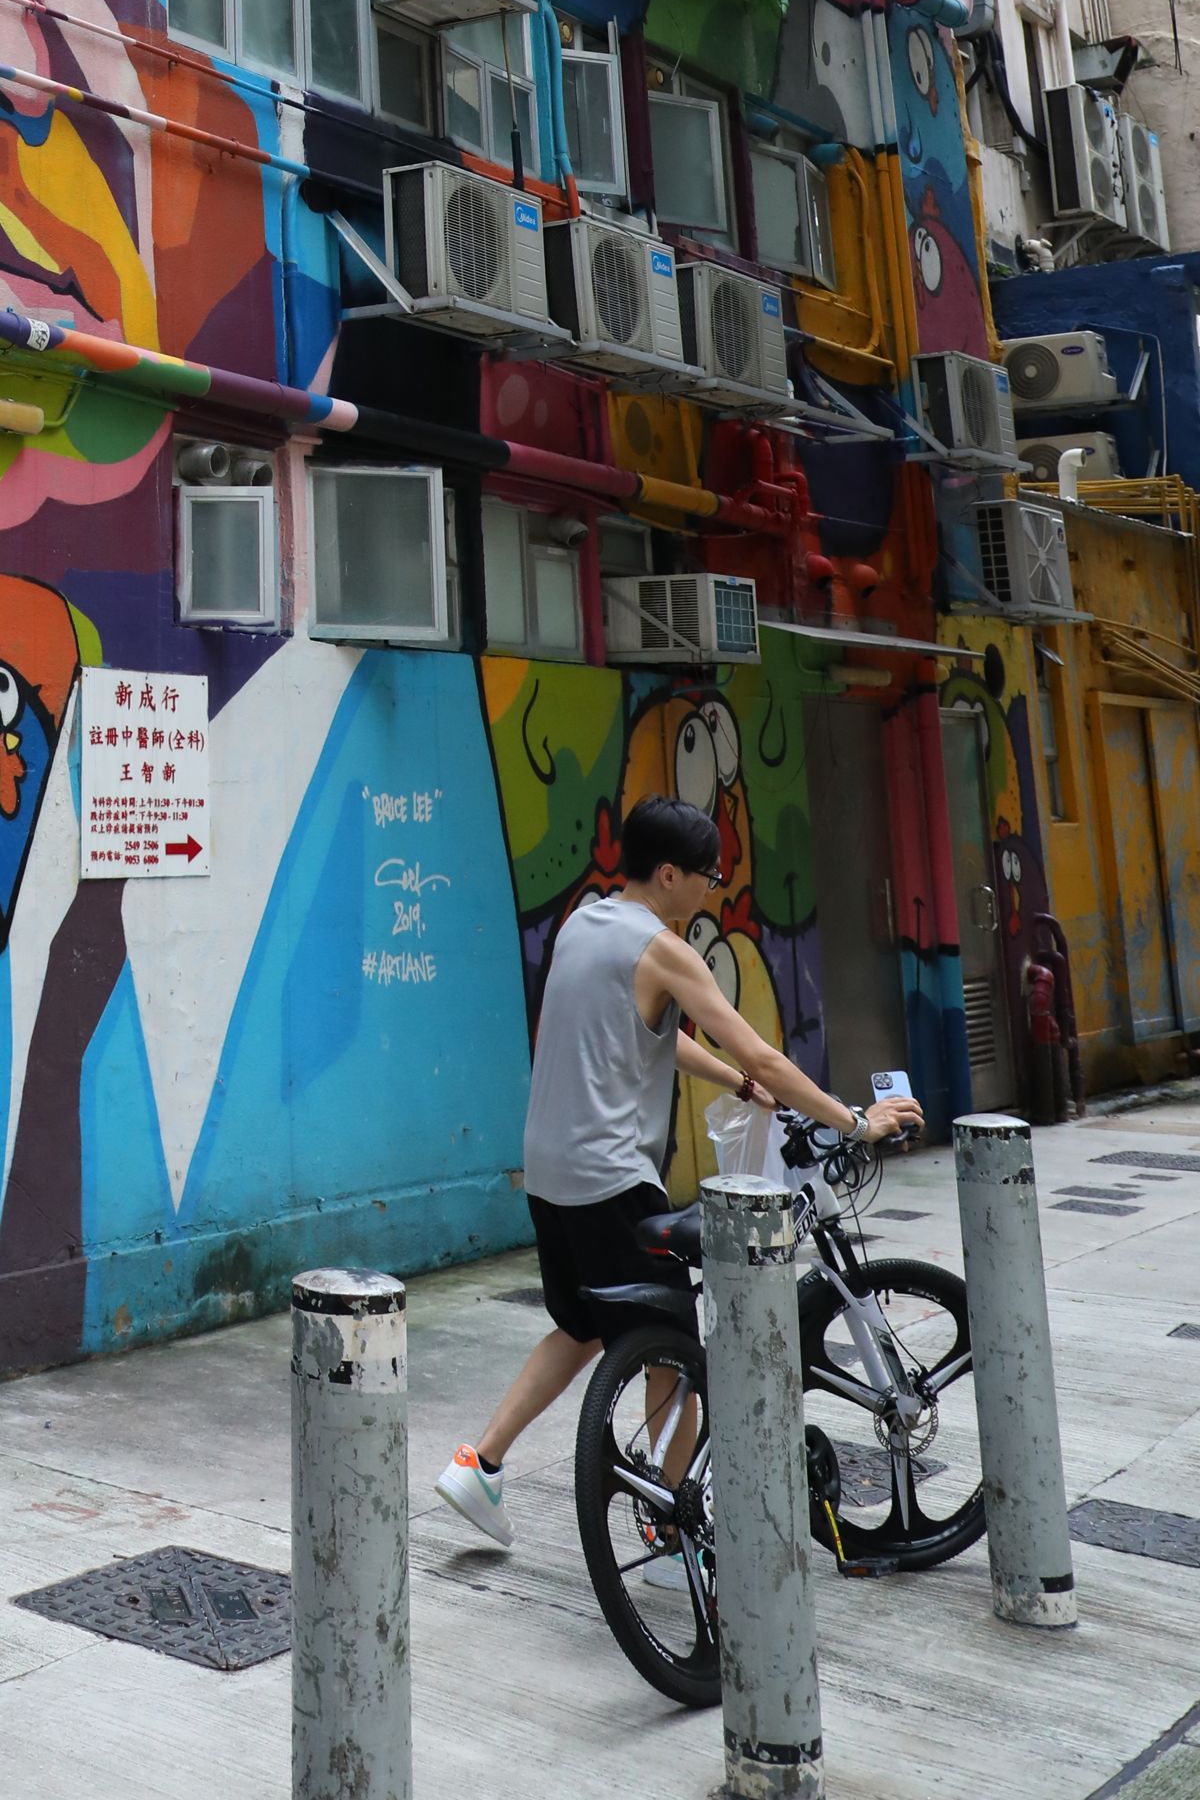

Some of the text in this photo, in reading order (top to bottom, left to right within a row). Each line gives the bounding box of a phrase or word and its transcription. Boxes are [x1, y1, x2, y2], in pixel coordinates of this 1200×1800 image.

[115, 681, 179, 713] 新成行
[89, 725, 205, 753] 註冊中醫師(全科)
[120, 762, 176, 784] 王智新
[124, 840, 159, 851] 2549 2506
[124, 854, 159, 865] 9053 6806
